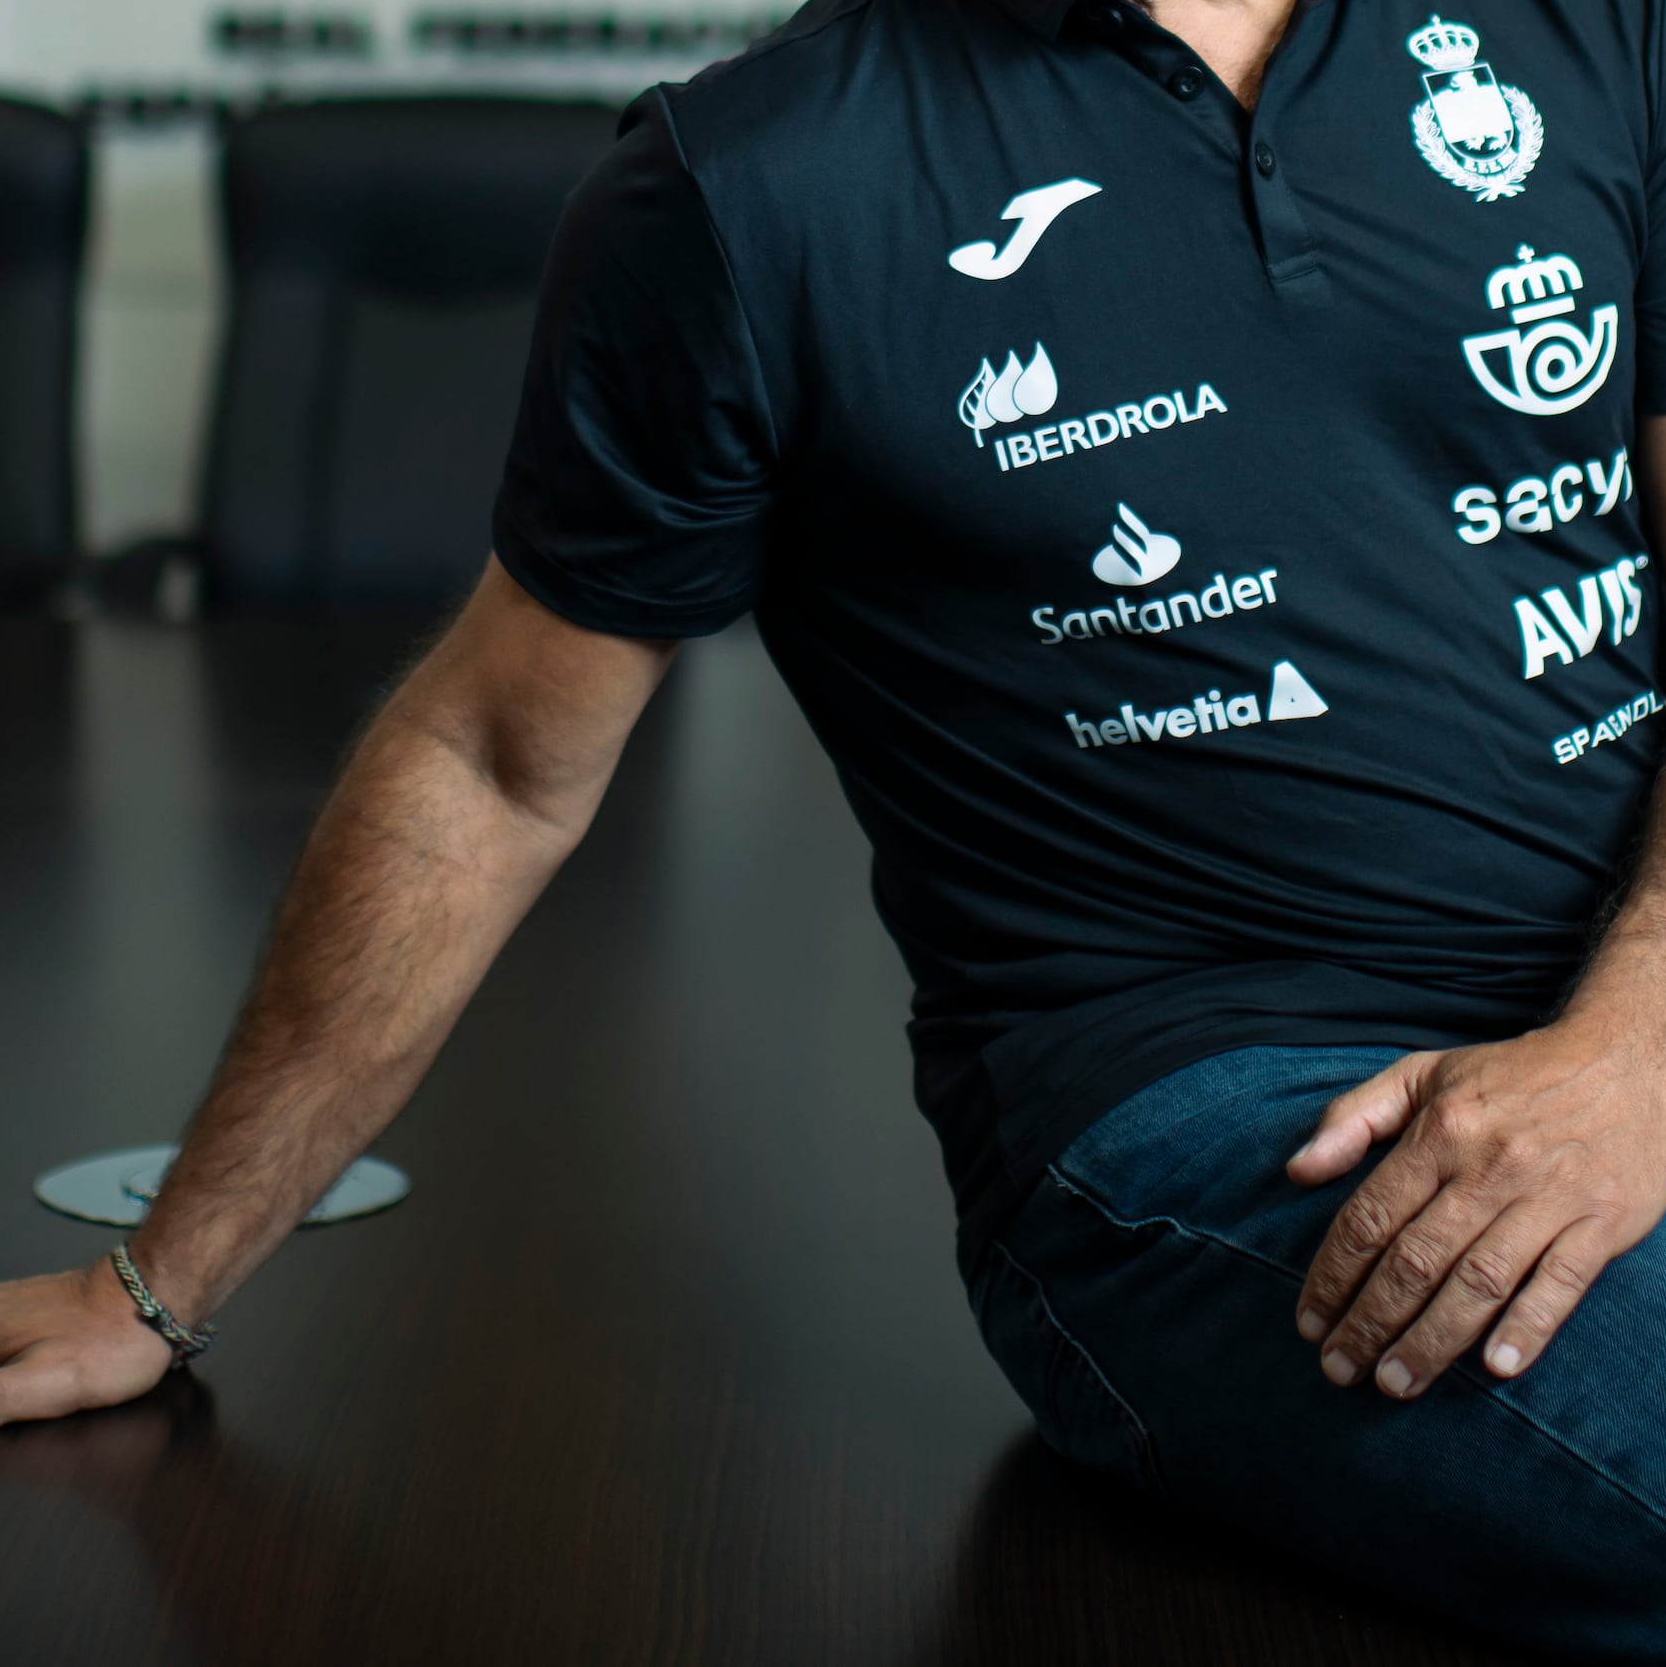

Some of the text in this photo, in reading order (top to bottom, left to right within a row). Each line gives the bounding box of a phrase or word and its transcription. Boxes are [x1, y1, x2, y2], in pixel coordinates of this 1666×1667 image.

[993, 382, 1229, 472] IBERDROLA
[1452, 445, 1634, 546] sacy
[1031, 567, 1278, 647] Santander
[1514, 559, 1642, 680] AVIS
[1064, 688, 1262, 749] helvetia
